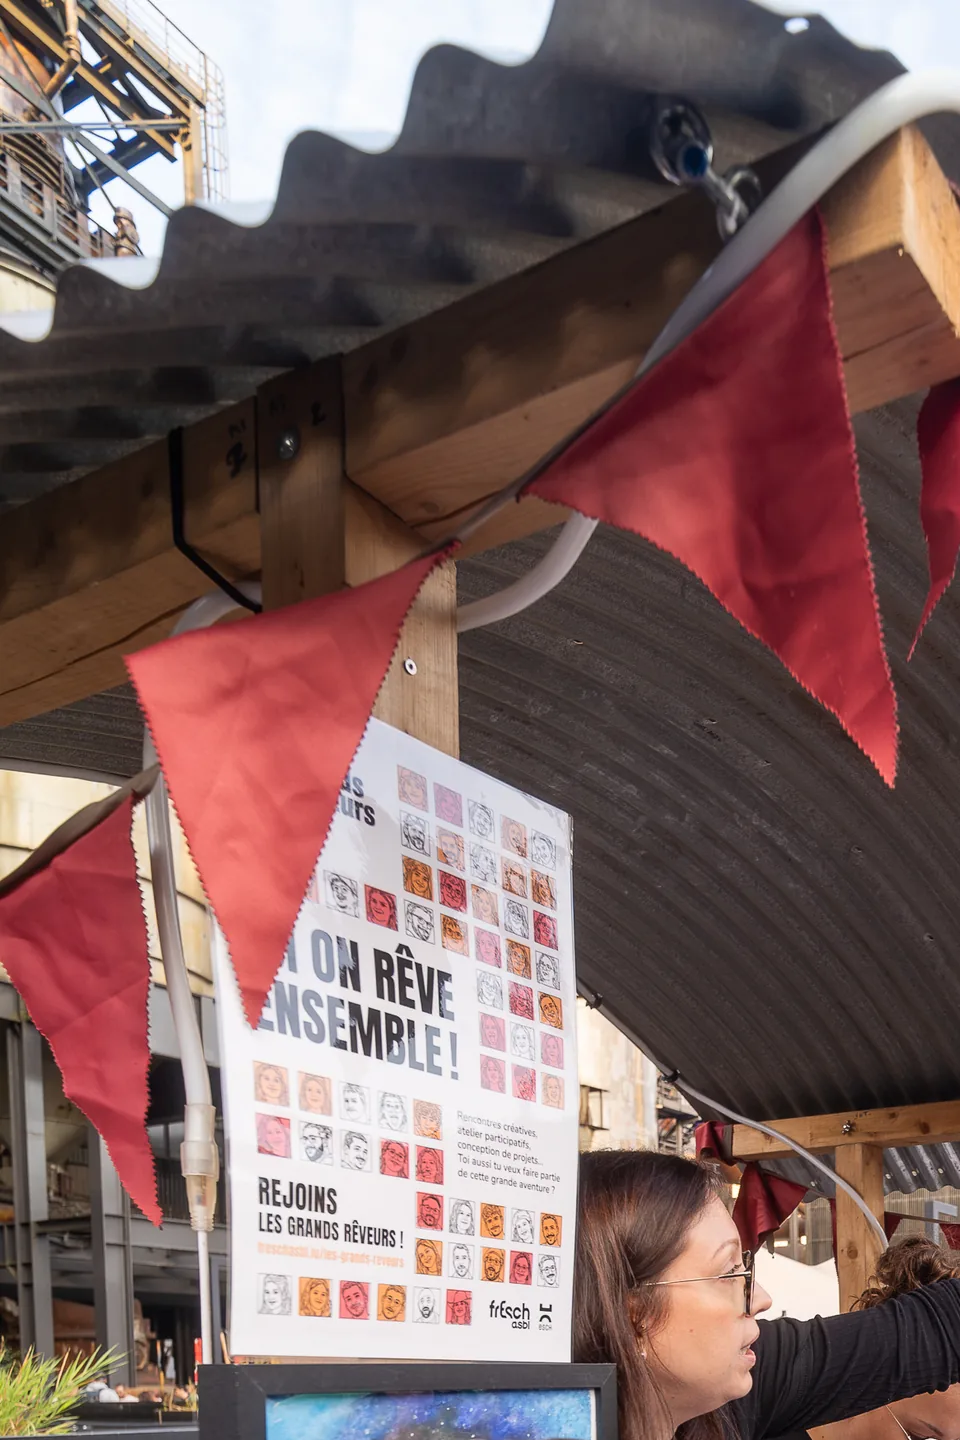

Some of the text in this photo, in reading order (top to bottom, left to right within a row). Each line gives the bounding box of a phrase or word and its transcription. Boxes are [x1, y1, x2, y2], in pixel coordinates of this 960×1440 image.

[311, 929, 361, 993] ON
[373, 943, 455, 1021] RÊVE
[457, 1110, 501, 1129] Rencontres
[457, 1126, 483, 1139] atelier
[457, 1141, 500, 1157] conception
[501, 1149, 511, 1160] de
[457, 1153, 561, 1183] Toi aussi tu veux faire partie
[457, 1168, 467, 1179] de
[470, 1171, 489, 1183] cette
[491, 1175, 518, 1189] grande
[519, 1180, 550, 1194] aventure
[258, 1176, 338, 1216] REJOINS
[258, 1211, 282, 1235] LES
[287, 1215, 339, 1241] GRANDS
[344, 1219, 396, 1248] RÊVEURS
